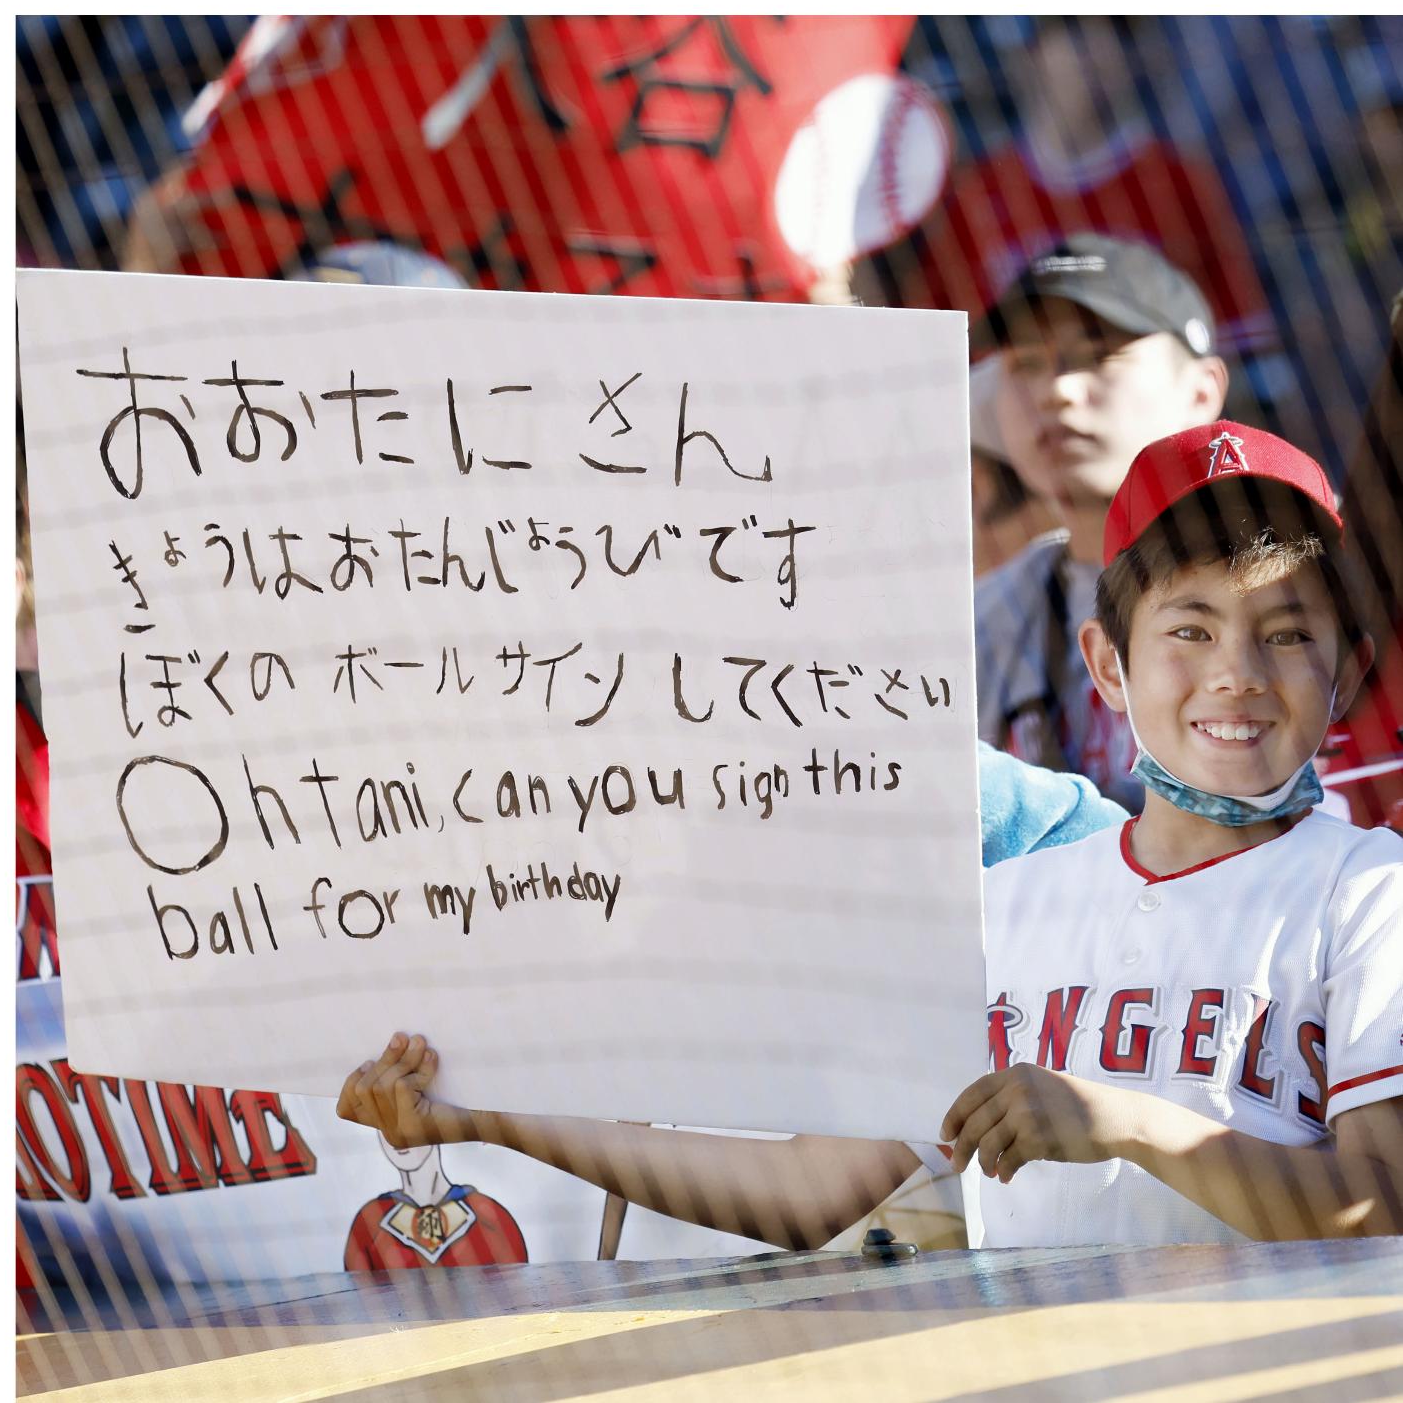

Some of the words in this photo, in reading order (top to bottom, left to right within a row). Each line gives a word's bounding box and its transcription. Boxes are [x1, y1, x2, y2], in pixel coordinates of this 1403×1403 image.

[116, 753, 445, 875] Ohtani,
[452, 768, 551, 825] can
[569, 764, 686, 833] you
[712, 761, 790, 820] sign
[803, 748, 902, 796] this
[147, 882, 279, 960] ball
[302, 876, 401, 940] for
[424, 880, 476, 935] my
[487, 861, 622, 923] birthday
[987, 984, 1329, 1128] ANGELS
[16, 1059, 317, 1204] OTIME
